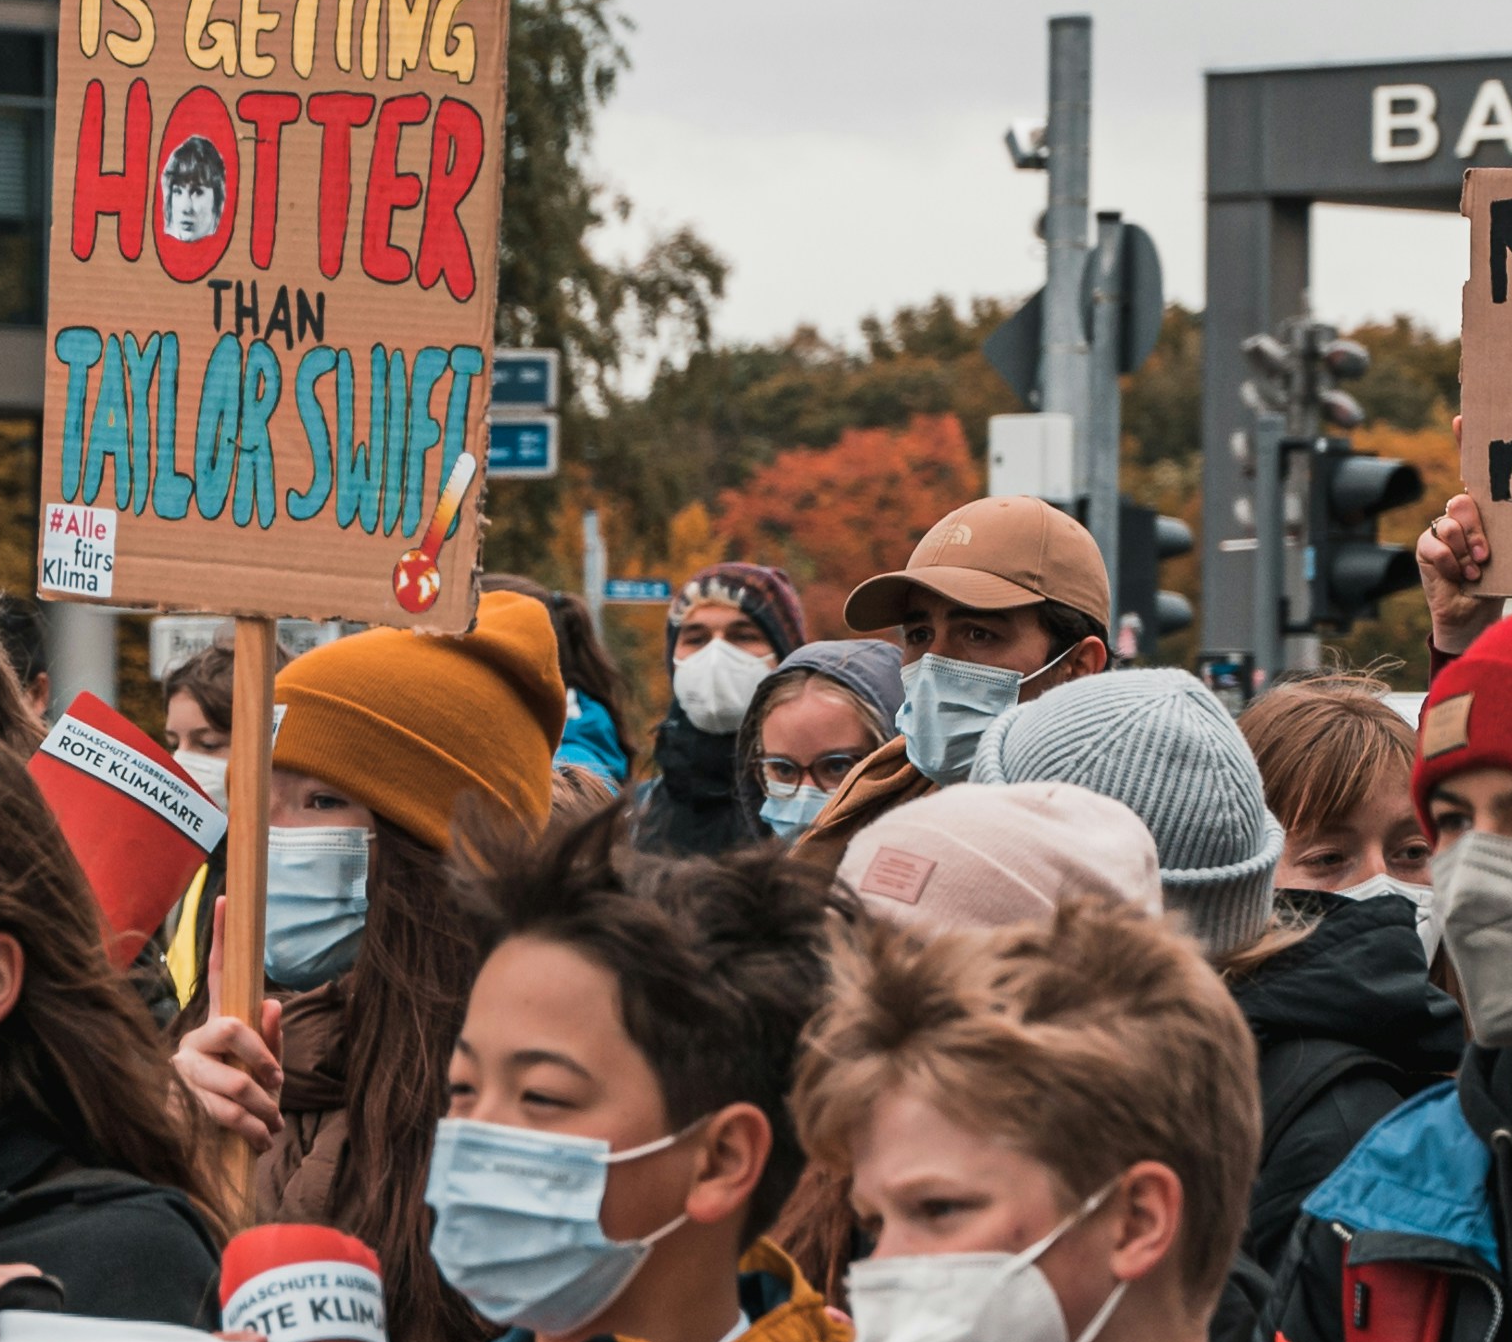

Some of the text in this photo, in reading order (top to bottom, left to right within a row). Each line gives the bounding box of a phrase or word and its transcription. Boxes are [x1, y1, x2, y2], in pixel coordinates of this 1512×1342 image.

[70, 76, 485, 303] HOTTER
[207, 279, 326, 350] THAN
[54, 326, 485, 540] TAYLOR SWIFT
[49, 508, 108, 541] #Alle
[42, 558, 99, 593] Klima
[73, 535, 114, 572] fürs
[65, 723, 131, 762] KLIMASCHUTZ
[58, 735, 204, 833] ROTE KLIMAKARTE
